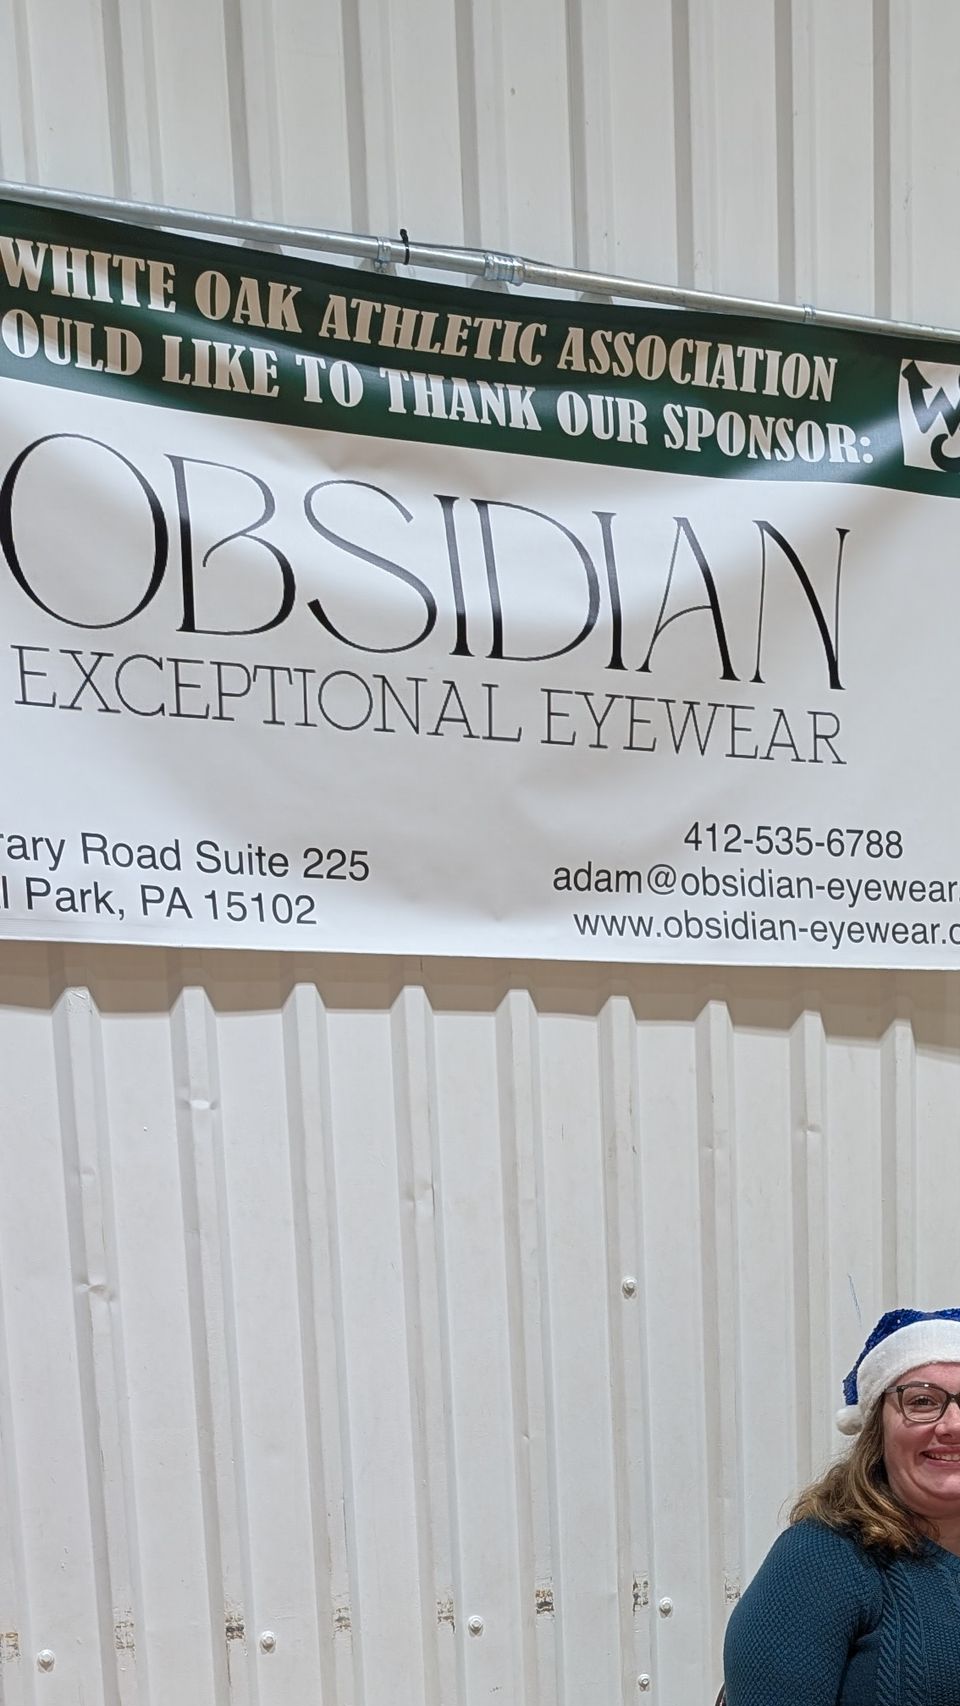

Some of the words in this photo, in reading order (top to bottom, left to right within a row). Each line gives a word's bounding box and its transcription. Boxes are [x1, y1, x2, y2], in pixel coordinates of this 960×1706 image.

[0, 235, 177, 313] WHITE
[194, 270, 302, 333] OAK
[318, 294, 547, 367] ATHLETIC
[557, 327, 838, 402] ASSOCIATION
[1, 308, 142, 376] OULD
[161, 334, 280, 398] LIKE
[295, 354, 364, 408] TO
[378, 367, 542, 432] THANK
[557, 390, 649, 446] OUR
[662, 403, 874, 464] SPONSOR:
[0, 433, 850, 690] OBSIDIAN
[10, 645, 522, 743] EXCEPTIONAL
[540, 688, 848, 765] EYEWEAR
[25, 876, 126, 920] Park,
[141, 885, 193, 919] PA
[205, 890, 318, 925] 15102
[80, 832, 181, 872] Road
[196, 840, 289, 878] Suite
[302, 848, 371, 882] 225
[684, 822, 903, 859] 412-535-6788
